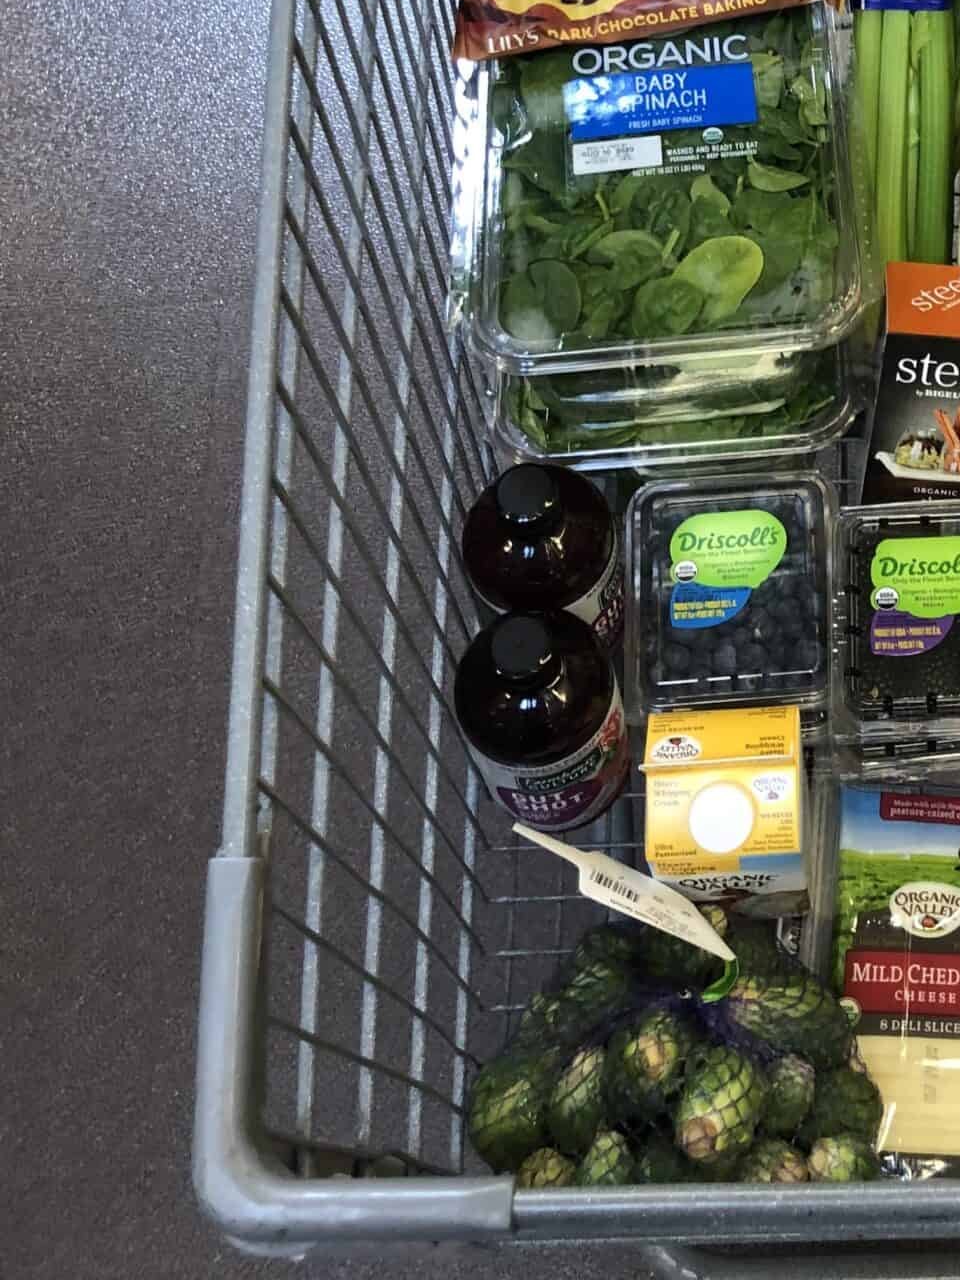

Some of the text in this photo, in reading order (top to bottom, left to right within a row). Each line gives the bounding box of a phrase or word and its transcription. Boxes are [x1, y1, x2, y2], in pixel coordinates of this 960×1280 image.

[597, 6, 698, 35] CHOCOLATE
[572, 34, 749, 75] ORGANIC
[635, 71, 688, 94] BABY
[913, 486, 959, 497] ORGANIC
[678, 527, 780, 552] Driscoll's
[901, 905, 960, 917] VALLEY
[852, 962, 903, 983] MILD
[894, 991, 957, 1004] CHEESE
[880, 1020, 887, 1031] 8
[891, 1020, 920, 1032] DELI
